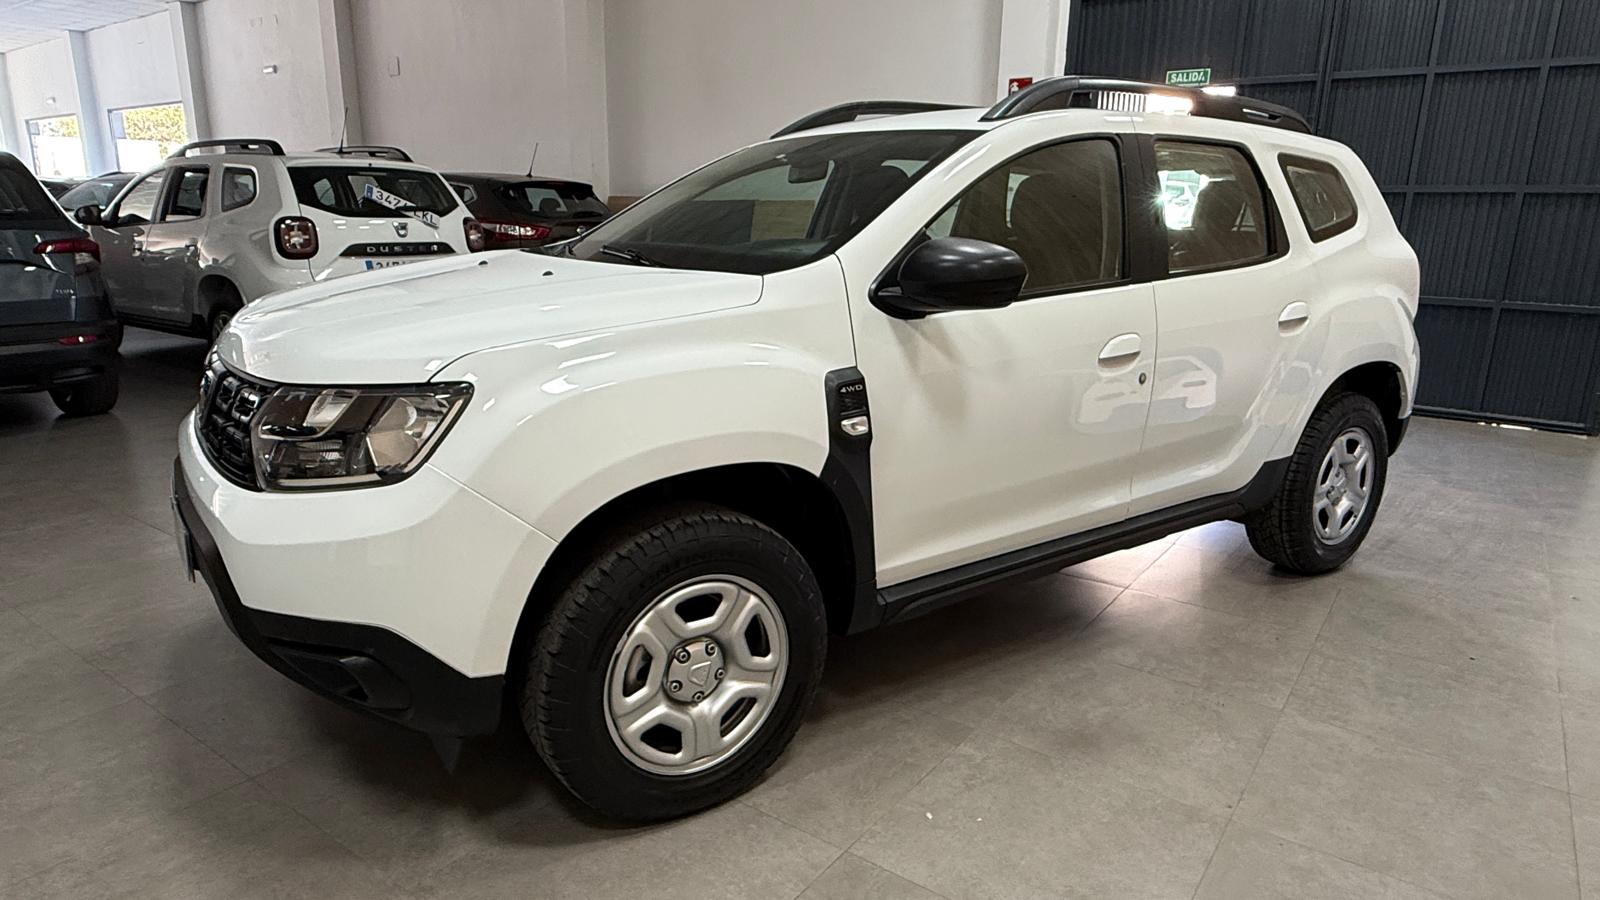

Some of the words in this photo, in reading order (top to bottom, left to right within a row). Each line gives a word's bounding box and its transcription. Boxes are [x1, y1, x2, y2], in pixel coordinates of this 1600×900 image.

[1170, 71, 1205, 83] SALIDA
[366, 244, 438, 253] DUSTER
[840, 384, 863, 392] 4WD
